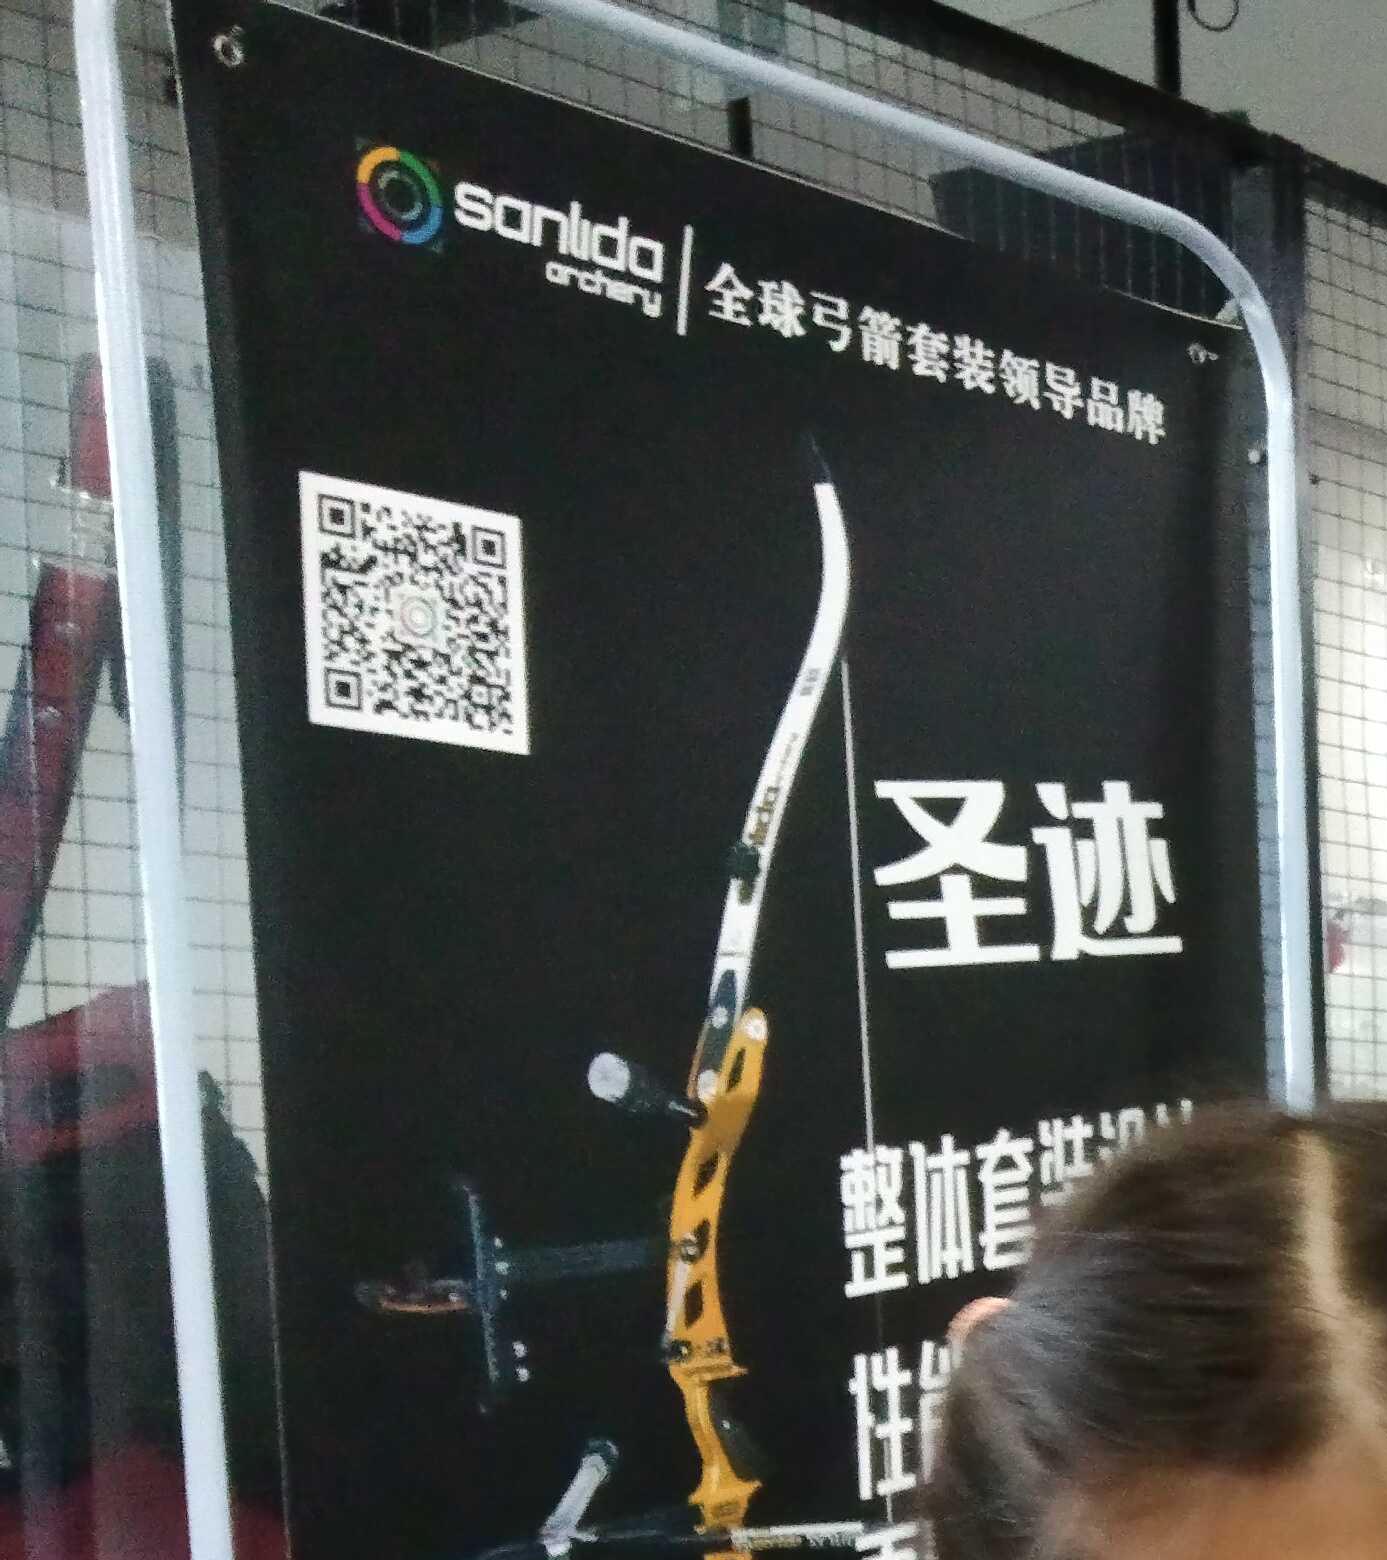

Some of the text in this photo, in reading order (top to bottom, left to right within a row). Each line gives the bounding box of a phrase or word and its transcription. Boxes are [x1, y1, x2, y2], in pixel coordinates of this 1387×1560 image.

[453, 179, 665, 283] sanlida
[545, 260, 662, 319] archery
[704, 262, 1168, 446] 全球弓箭套装领导品牌
[873, 779, 1184, 970] 圣迹
[840, 1098, 1192, 1297] 整体套装
